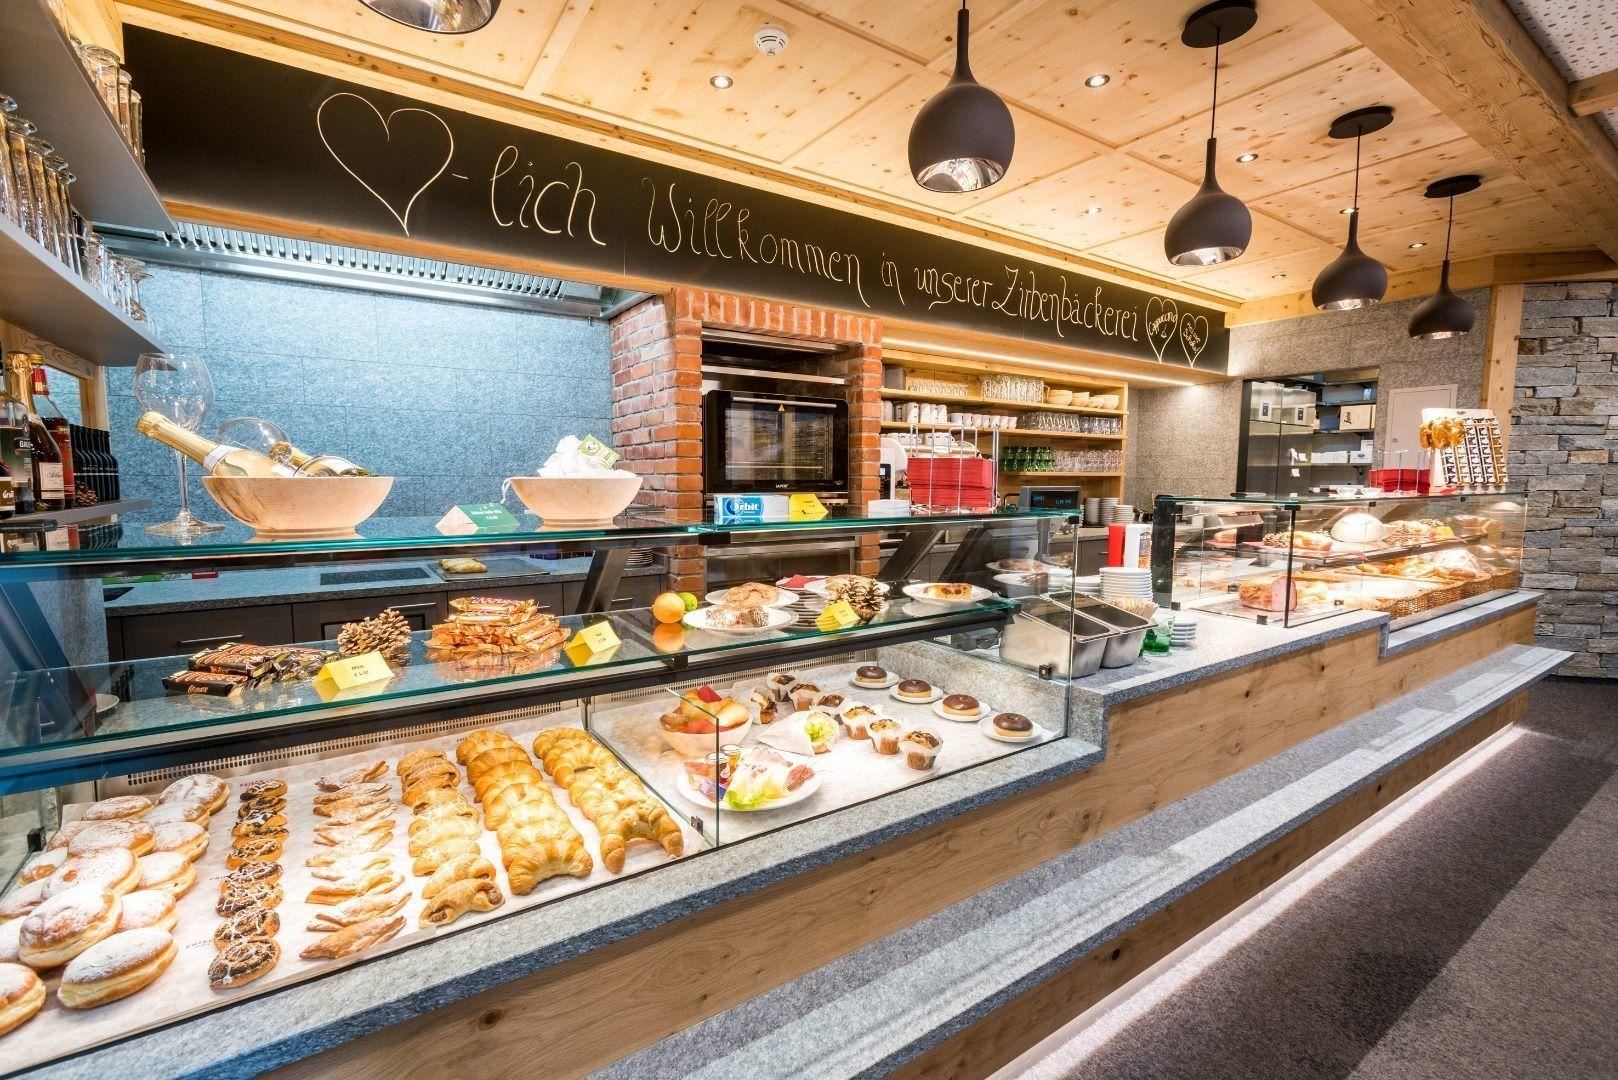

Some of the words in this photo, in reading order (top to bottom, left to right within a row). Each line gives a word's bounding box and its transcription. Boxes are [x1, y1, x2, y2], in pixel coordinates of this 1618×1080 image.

[641, 176, 871, 308] Willkommen
[881, 252, 906, 306] in
[913, 266, 993, 311] unserer
[991, 264, 1139, 342] Zirbenbäckerei
[733, 501, 760, 512] Orbit
